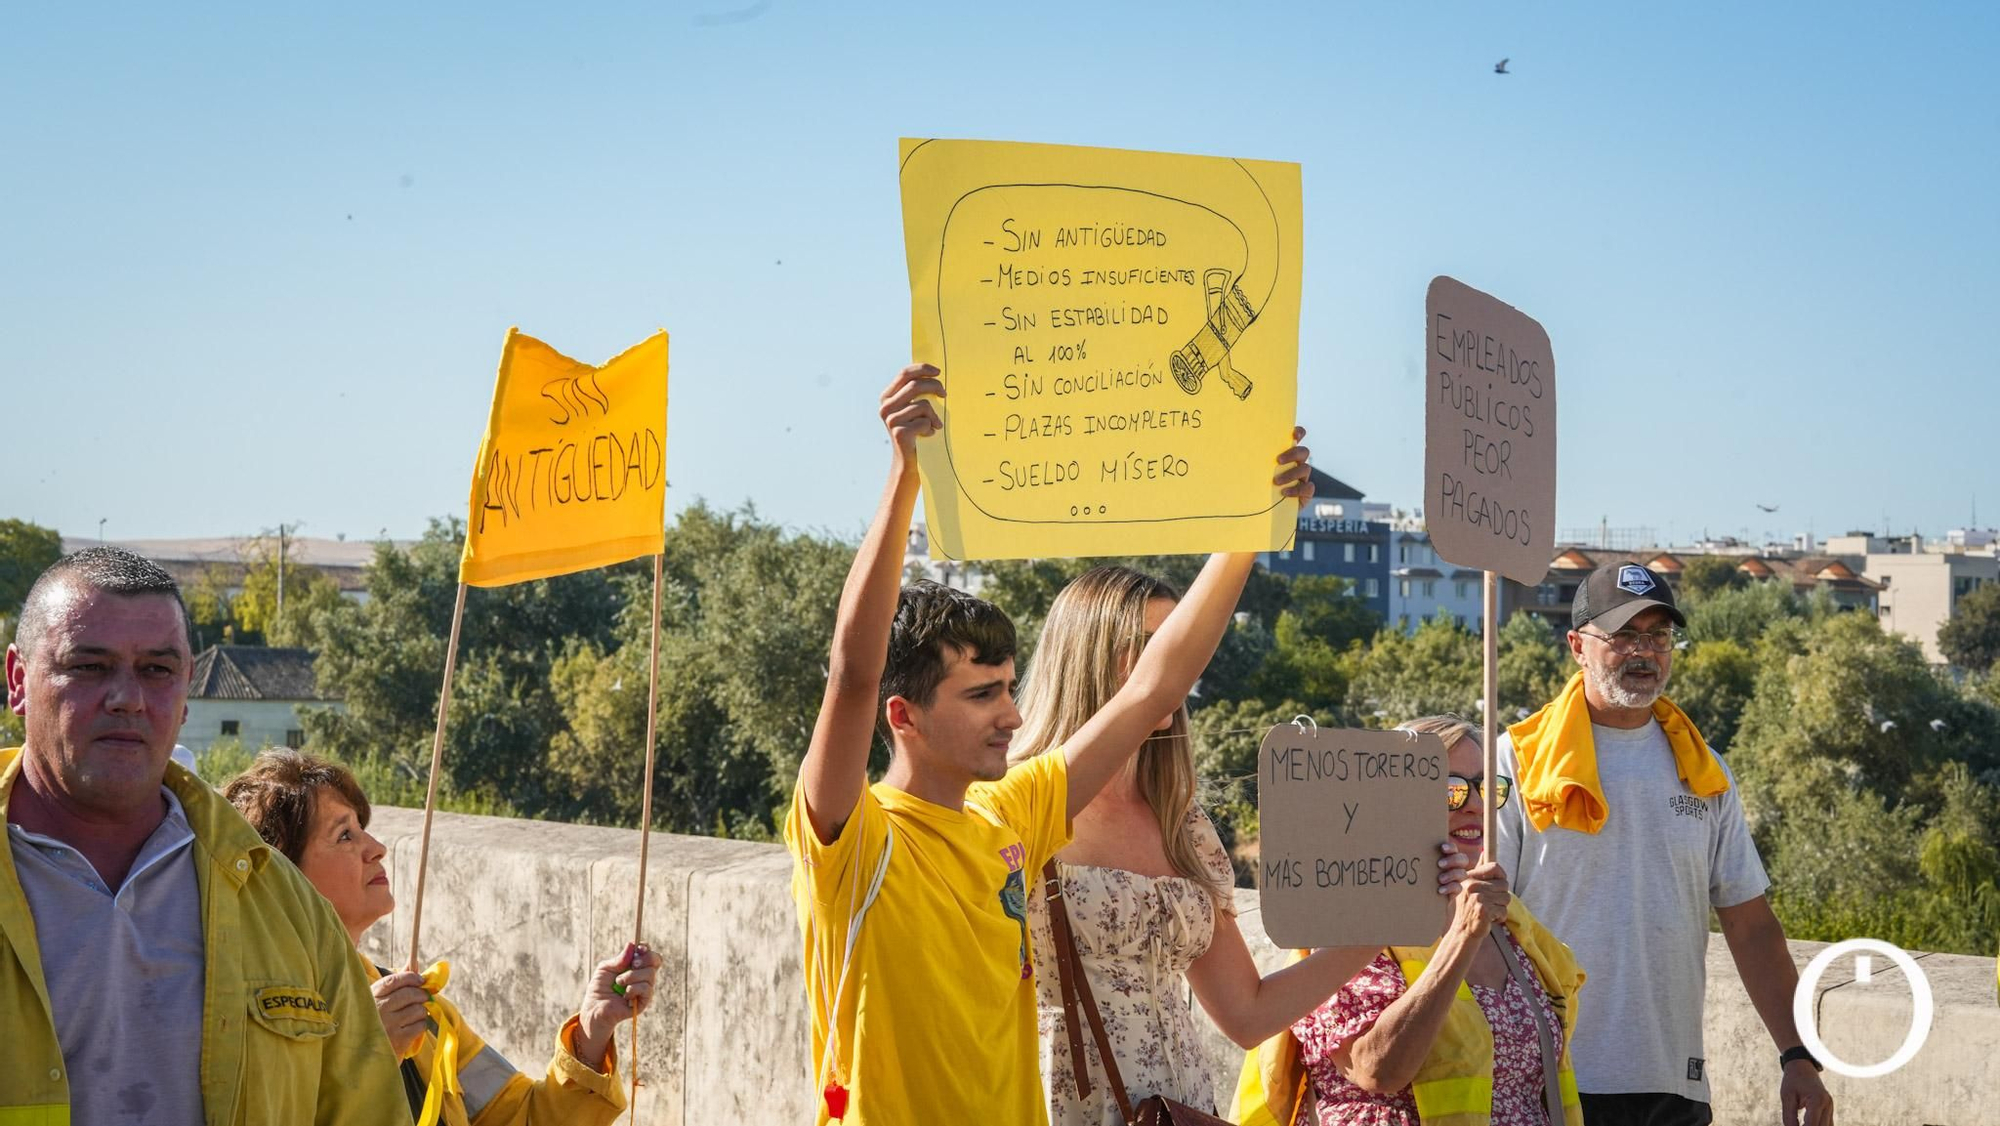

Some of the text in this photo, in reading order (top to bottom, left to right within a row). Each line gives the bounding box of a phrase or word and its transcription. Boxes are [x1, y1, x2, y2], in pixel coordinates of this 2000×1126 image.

[1080, 265, 1196, 286] INSUFICIENTES
[1050, 300, 1169, 328] ESTABILIDAD
[1013, 338, 1087, 365] AL 100%
[1435, 312, 1544, 400] EMPLEADOS
[1053, 360, 1164, 396] CONCILIACIÓN
[540, 373, 610, 426] SIN
[1440, 370, 1535, 438] PÚBLICOS
[1083, 409, 1202, 436] INCOMPLETAS
[1100, 451, 1190, 483] MÍSERO
[1463, 428, 1513, 481] PEOR
[1299, 516, 1369, 534] HESPERIA
[1441, 472, 1532, 547] PAGADOS
[1271, 746, 1441, 785] MENOS TOREROS
[1343, 802, 1359, 834] Y
[1669, 795, 1709, 812] GLASGOW
[1265, 851, 1421, 891] MÁS BOMBEROS
